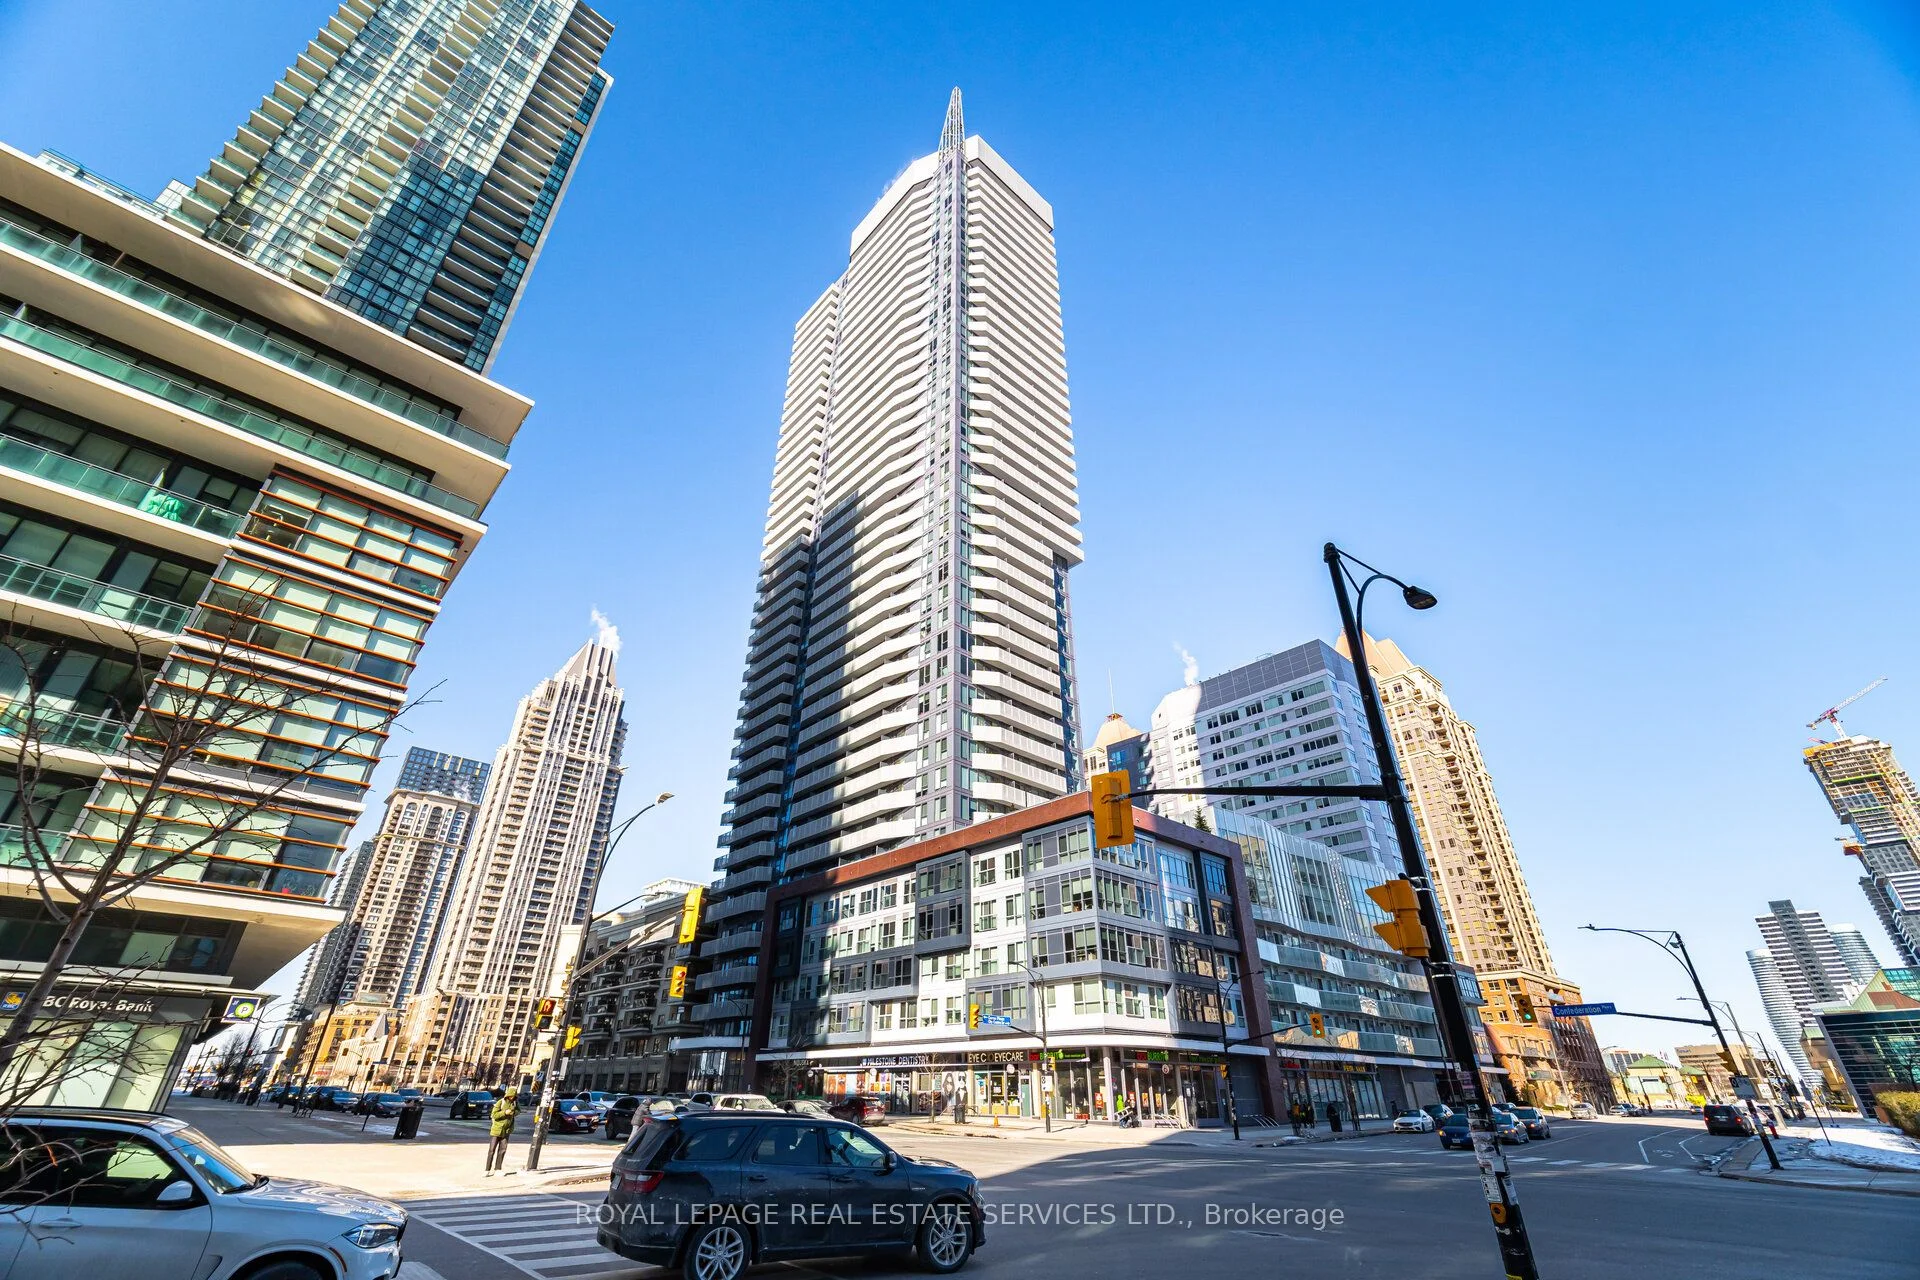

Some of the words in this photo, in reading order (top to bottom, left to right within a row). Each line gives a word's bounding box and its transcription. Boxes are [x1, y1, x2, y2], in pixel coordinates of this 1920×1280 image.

[1554, 1006, 1602, 1015] Confederation
[867, 1056, 897, 1066] MILESTONE
[898, 1055, 930, 1066] DENTISTRY
[994, 1051, 1024, 1062] EYECARE
